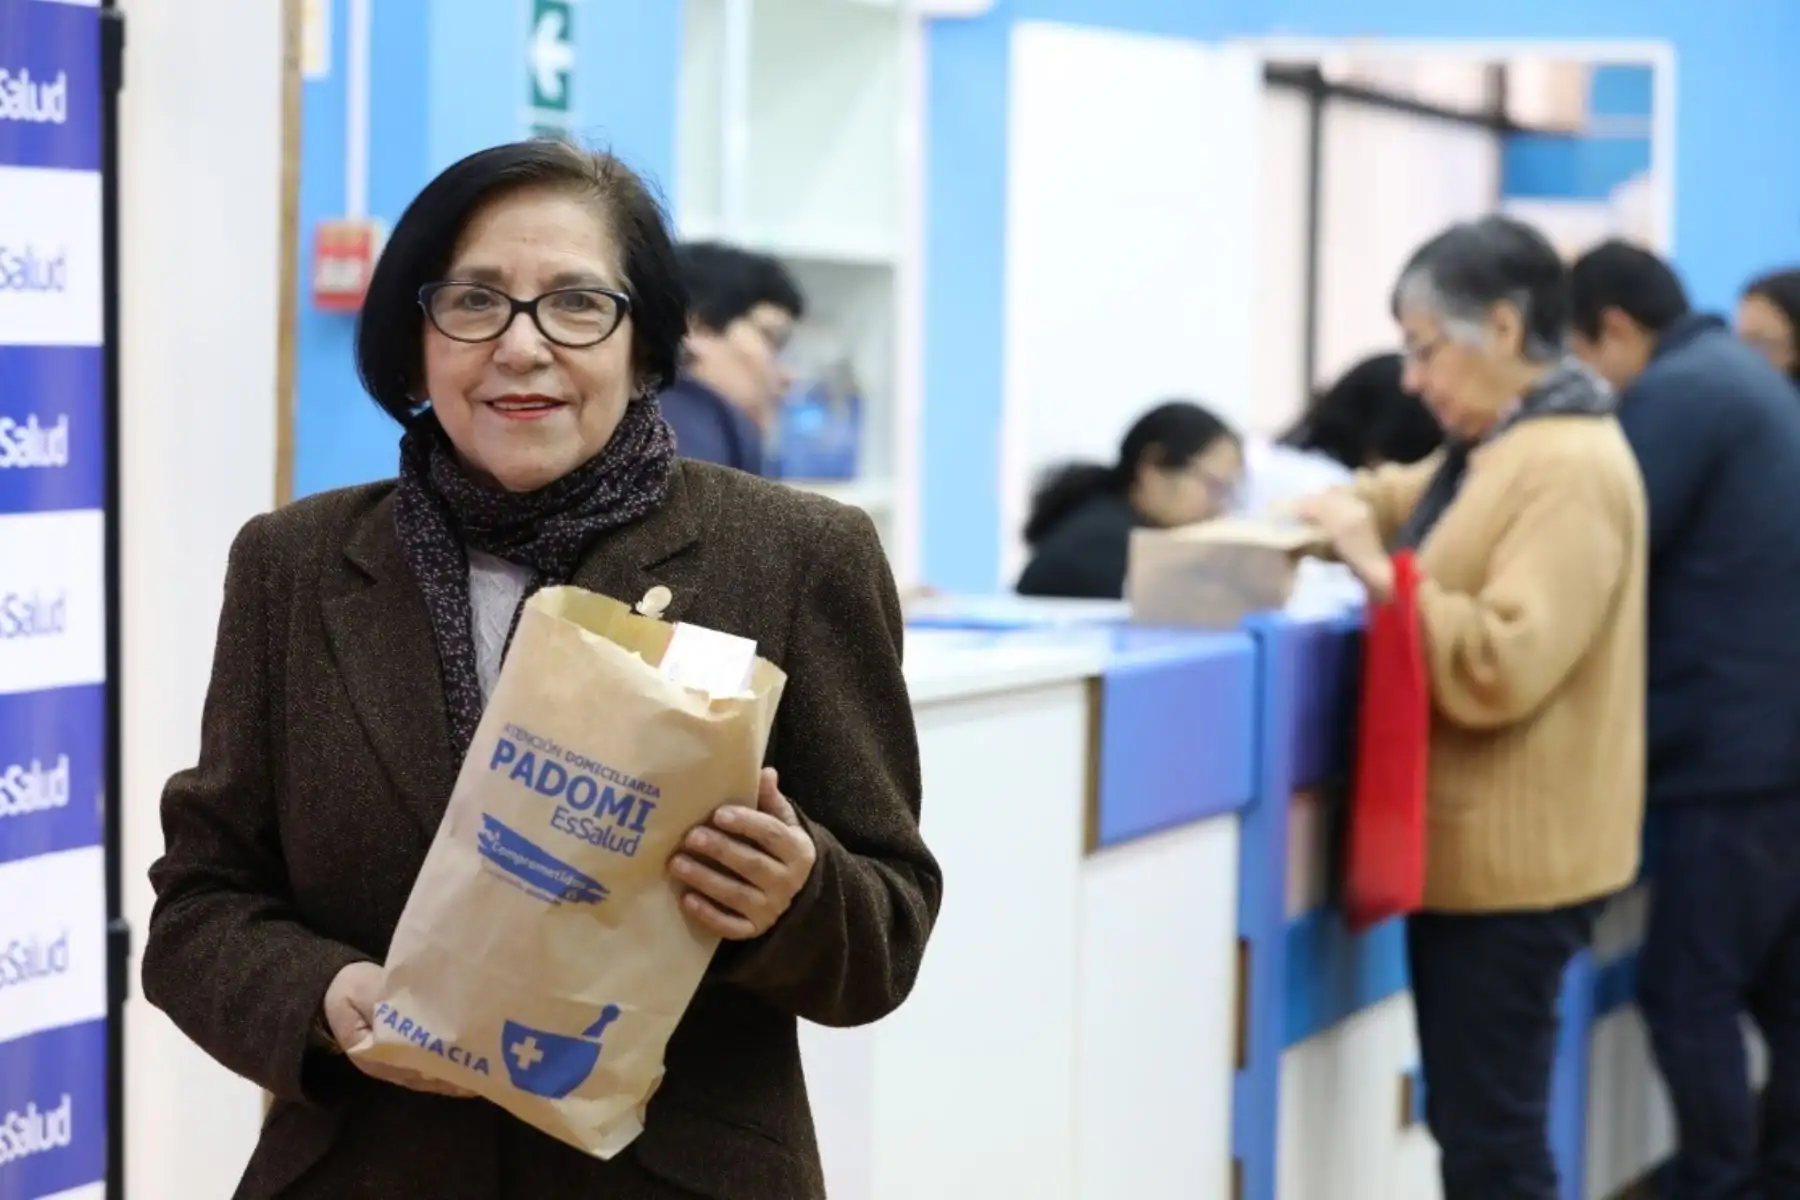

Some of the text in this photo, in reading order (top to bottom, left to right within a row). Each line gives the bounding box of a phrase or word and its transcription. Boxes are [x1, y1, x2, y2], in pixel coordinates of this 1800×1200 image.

[490, 737, 656, 833] PADOMI
[565, 750, 661, 799] DOMICILIARIA
[550, 805, 641, 857] EsSalud
[375, 1003, 490, 1077] FARMACIA
